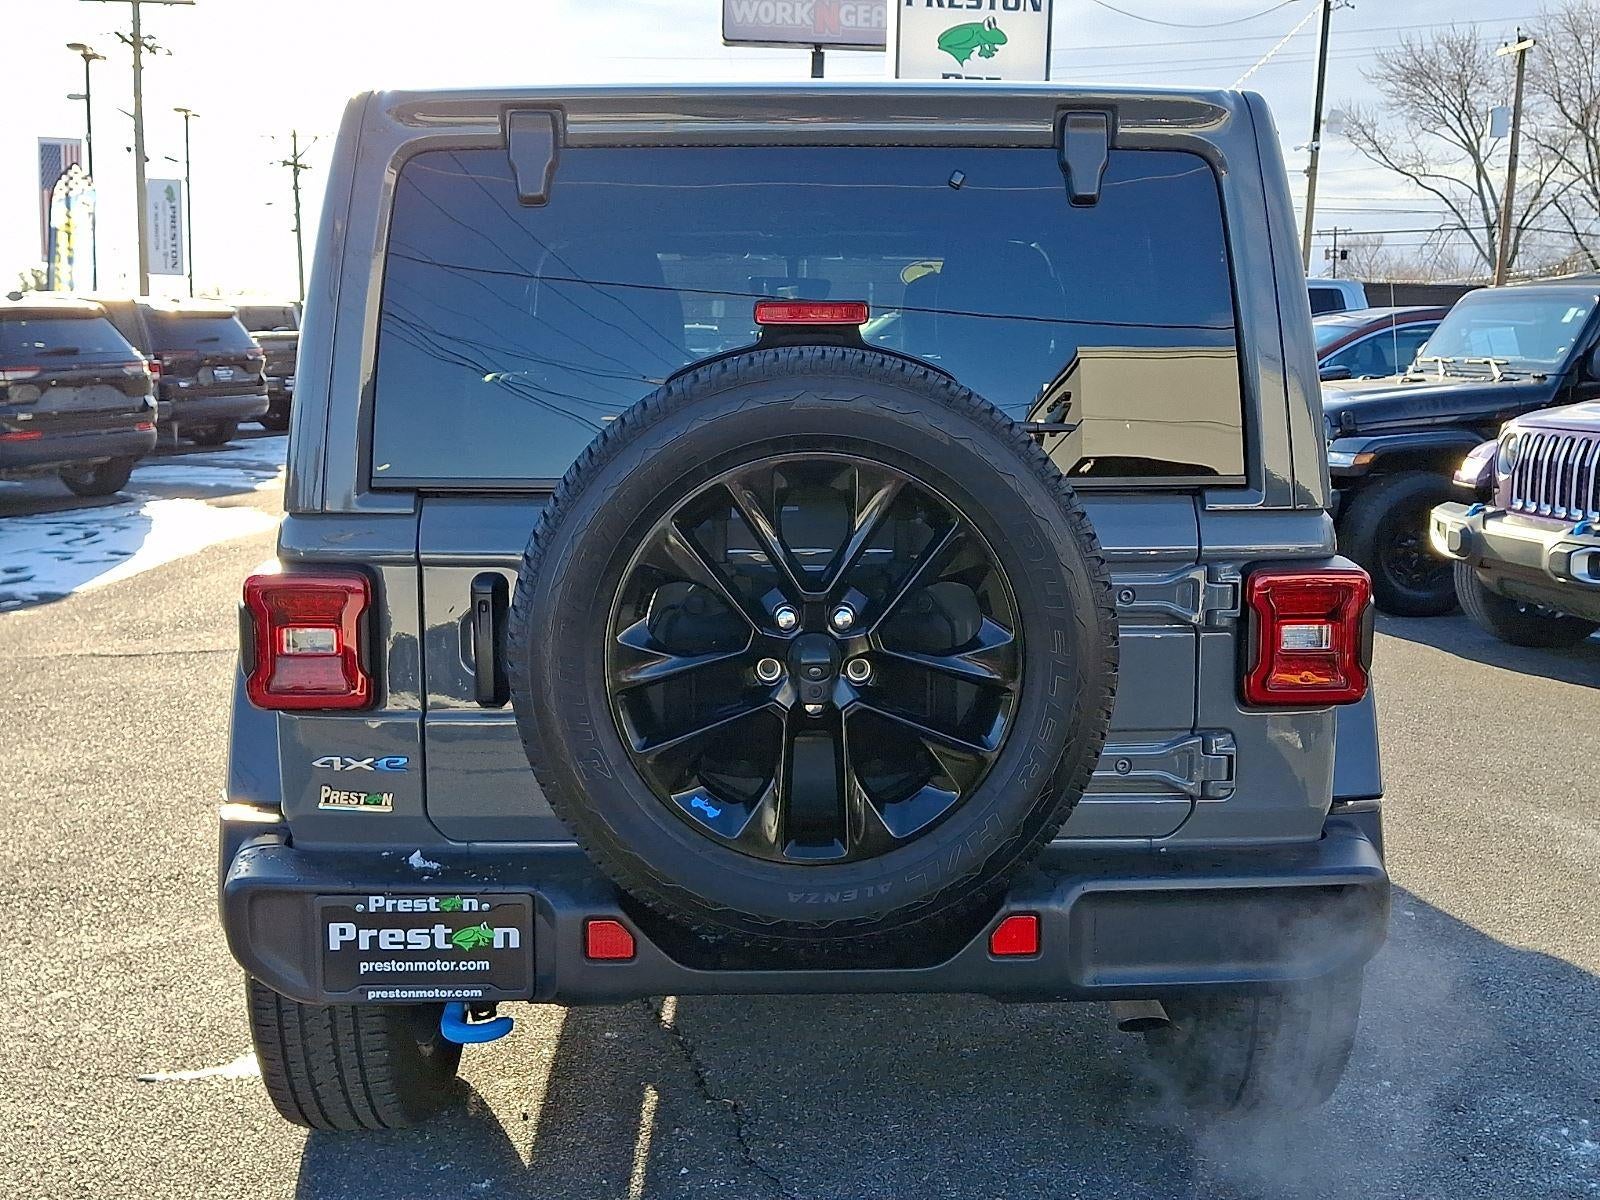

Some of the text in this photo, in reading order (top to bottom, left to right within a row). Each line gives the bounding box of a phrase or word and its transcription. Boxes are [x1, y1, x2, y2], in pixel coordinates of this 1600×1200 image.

[320, 784, 394, 806] PRESTN
[368, 894, 479, 913] Prestn
[787, 883, 894, 906] ALENZA
[328, 921, 521, 952] Prestn
[359, 958, 491, 975] prestonmotor.com
[367, 987, 483, 1000] prestonmotor.com
